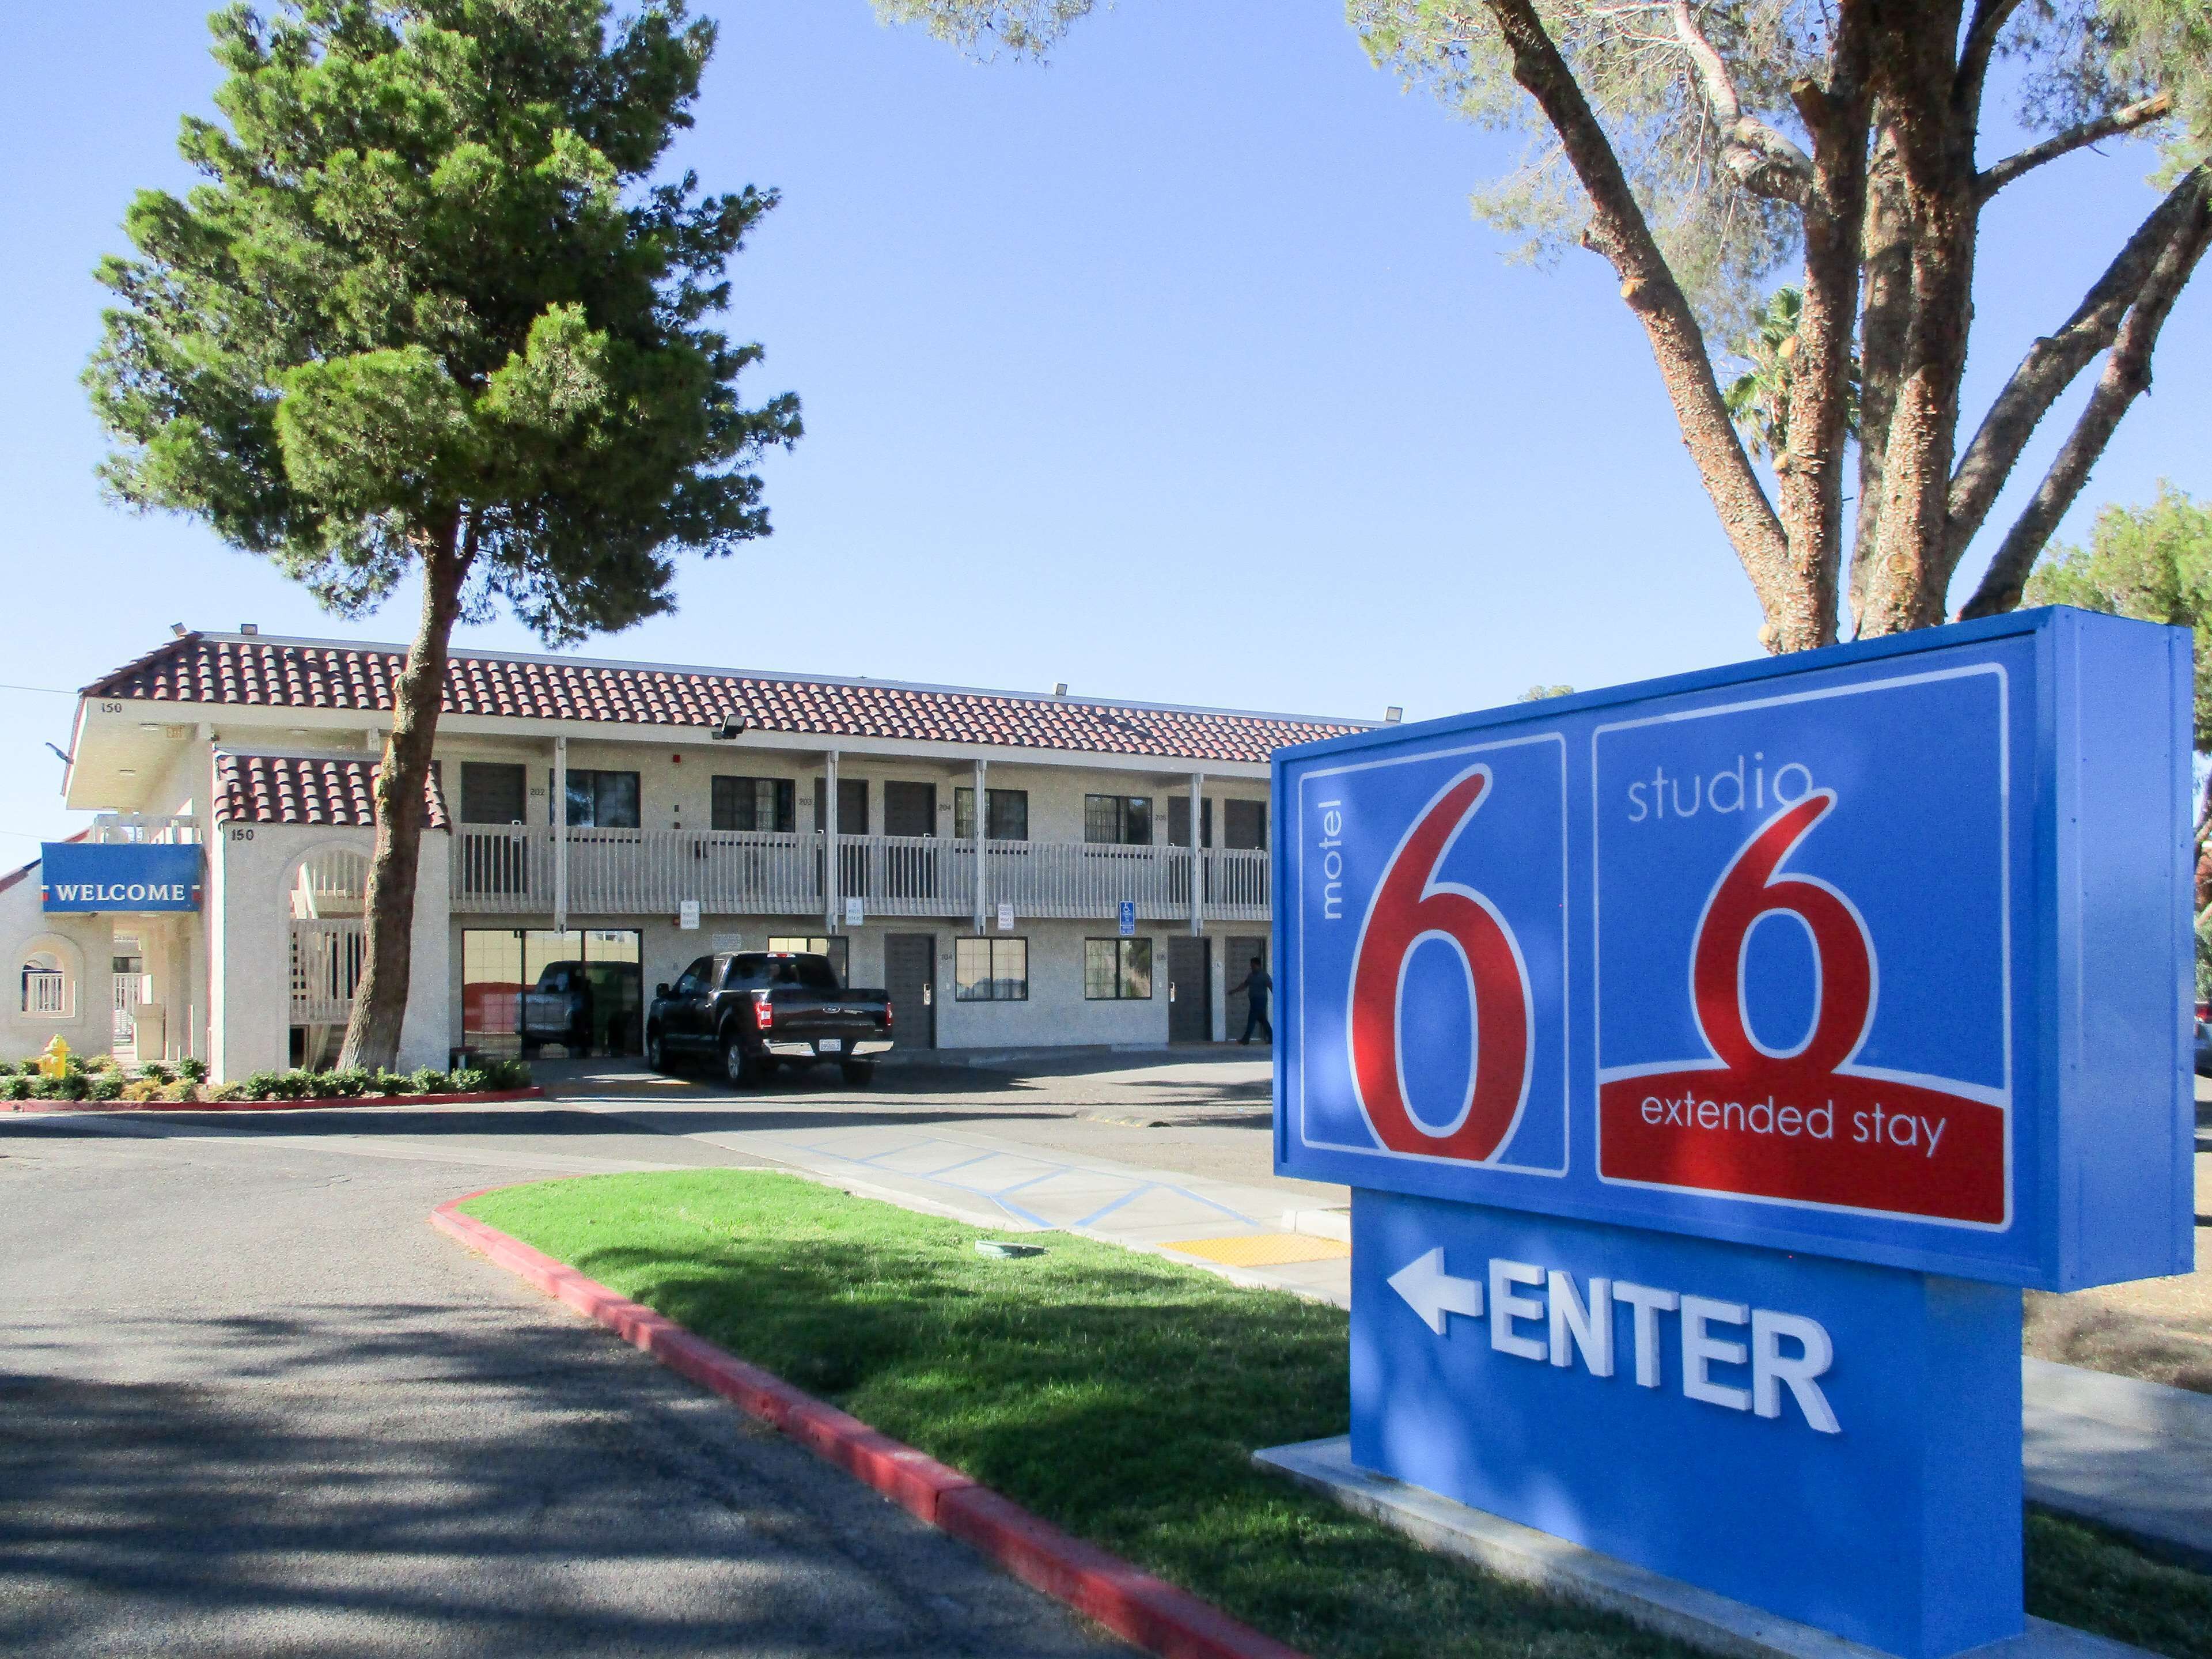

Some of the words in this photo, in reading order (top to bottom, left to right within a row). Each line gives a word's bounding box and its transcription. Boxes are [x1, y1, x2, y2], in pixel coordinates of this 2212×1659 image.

[101, 703, 122, 713] 150
[1627, 751, 1813, 823] studio
[232, 829, 254, 840] 150
[1317, 799, 1343, 920] motel
[55, 884, 185, 901] WELCOME
[1346, 763, 1535, 1169] 6
[1688, 787, 1879, 1074] 6
[1641, 1090, 1834, 1139] extended
[1853, 1103, 1947, 1159] stay
[1489, 1258, 1841, 1434] ENTER
